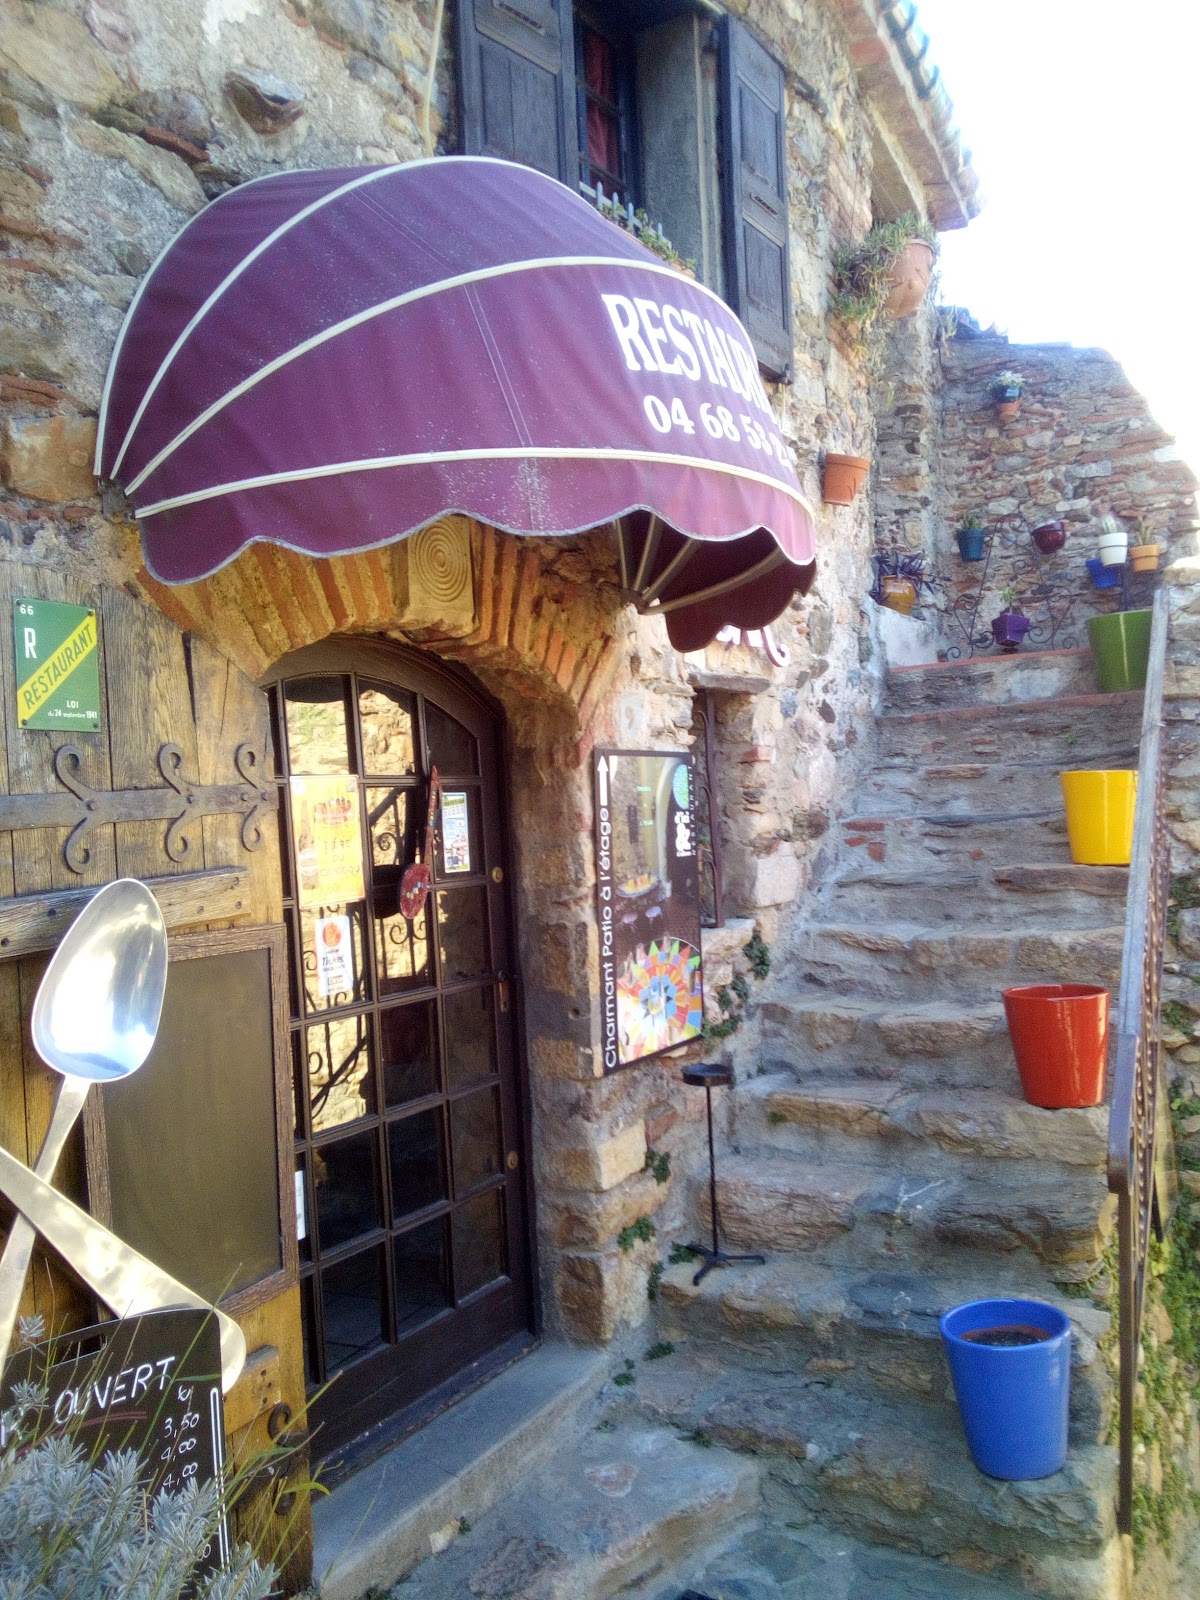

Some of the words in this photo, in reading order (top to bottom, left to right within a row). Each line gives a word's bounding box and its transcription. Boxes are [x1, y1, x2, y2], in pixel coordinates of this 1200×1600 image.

[643, 395, 695, 434] 04
[699, 403, 740, 442] 68
[740, 413, 773, 456] 53
[20, 604, 34, 616] 66
[24, 627, 37, 659] R
[22, 623, 94, 710] RESTAURANT
[66, 700, 79, 708] LOI
[599, 807, 612, 880] l'étage
[600, 886, 612, 901] à
[601, 905, 613, 957] Patio
[602, 961, 617, 1068] Charmant
[54, 1356, 176, 1424] OUVERT
[164, 1412, 200, 1438] 3,50
[160, 1438, 197, 1461] 4,00
[163, 1462, 199, 1488] 4,00
